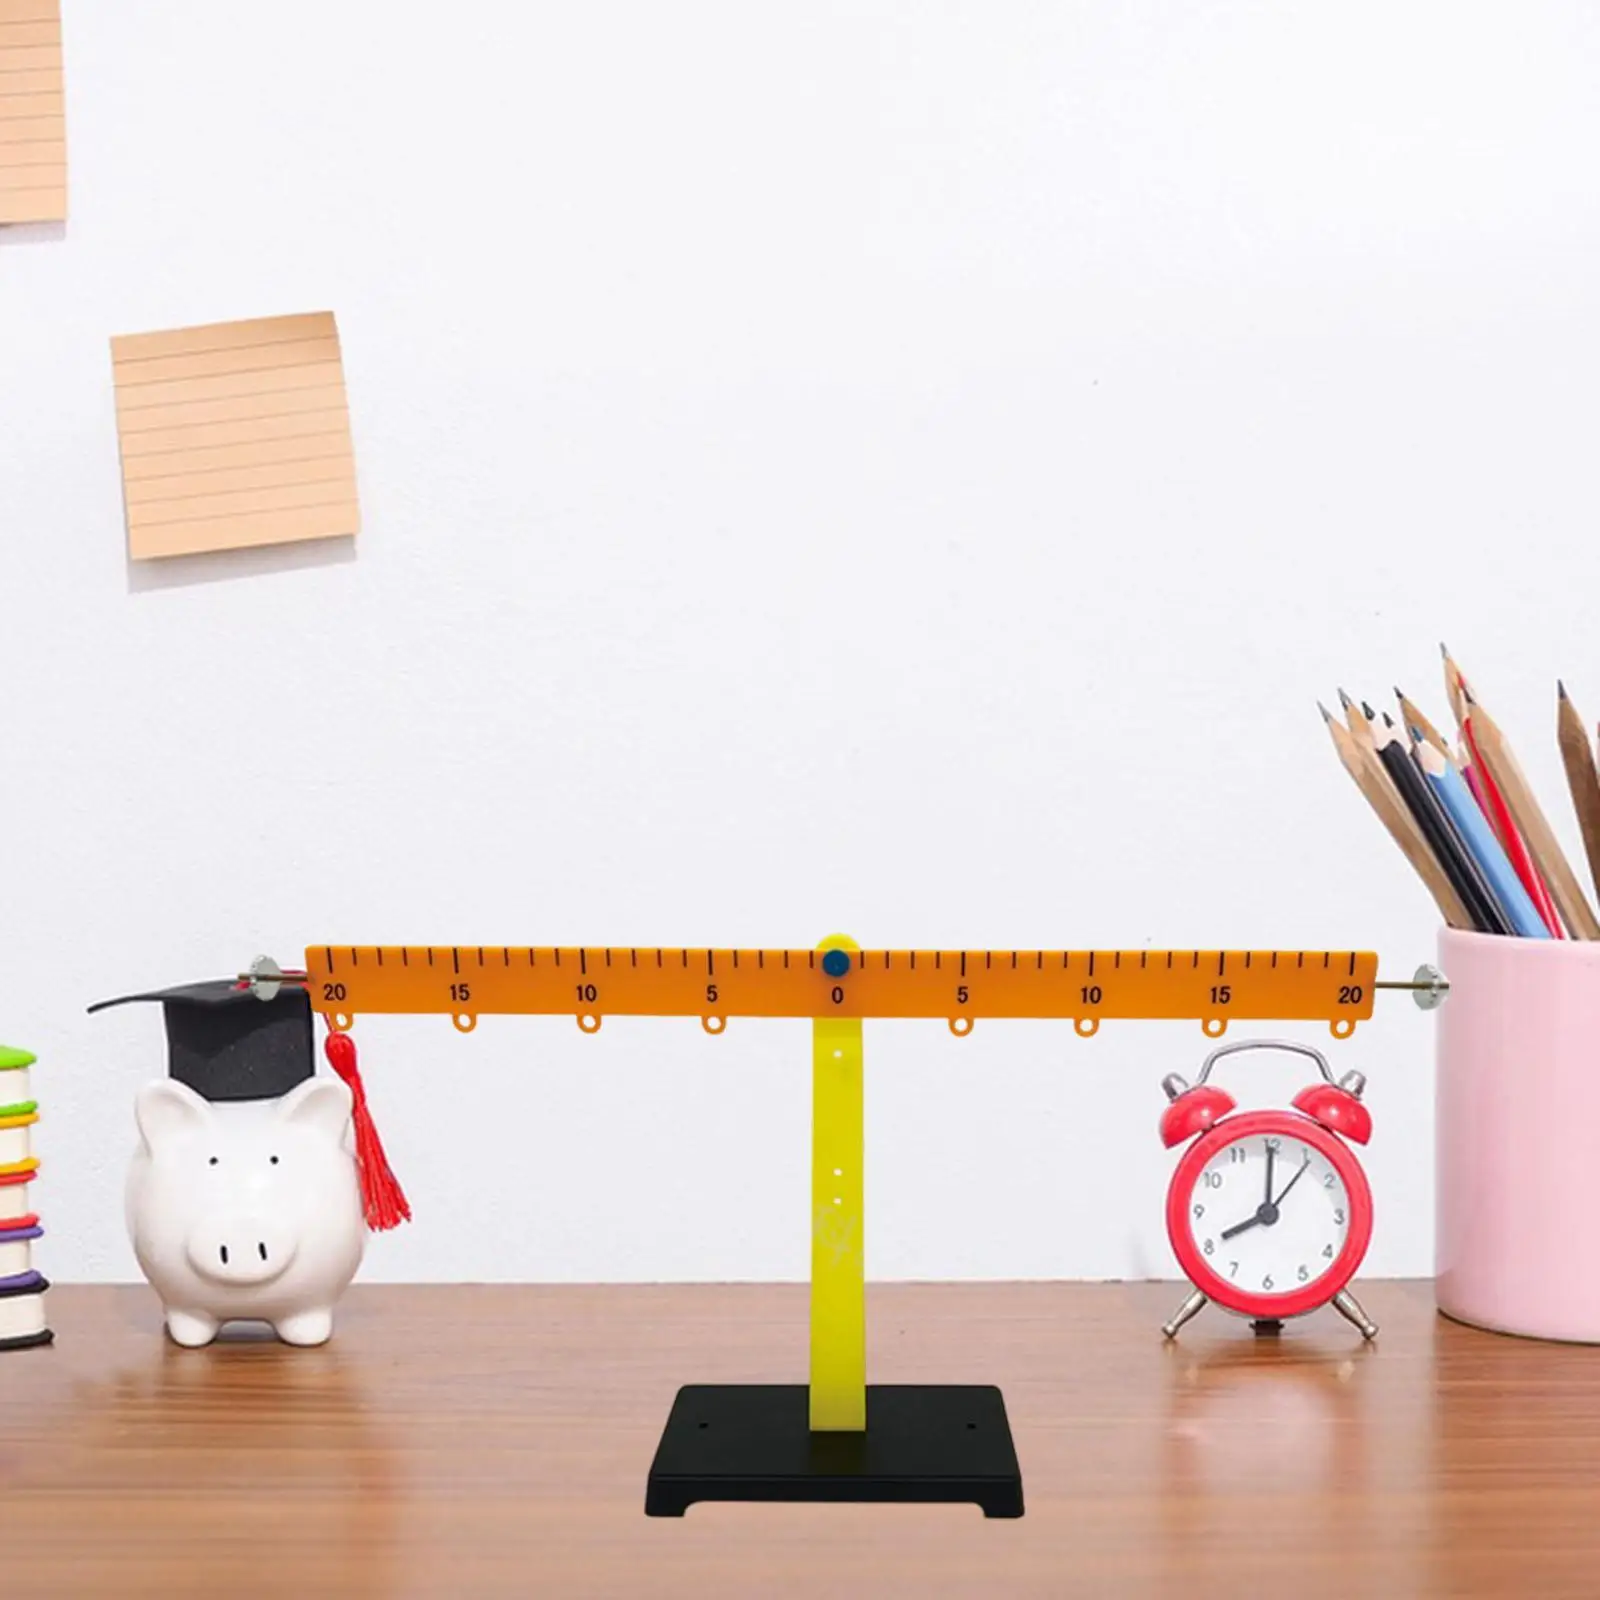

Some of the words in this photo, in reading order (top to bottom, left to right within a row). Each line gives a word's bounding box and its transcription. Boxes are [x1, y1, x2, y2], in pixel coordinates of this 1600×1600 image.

[324, 983, 346, 1001] 20
[450, 983, 470, 1002] 15
[576, 985, 597, 1003] 10
[706, 984, 718, 1003] 5
[831, 986, 844, 1005] 0
[957, 985, 969, 1004] 5
[1080, 986, 1102, 1005] 10
[1210, 986, 1231, 1005] 15
[1338, 985, 1362, 1005] 20
[1263, 1137, 1281, 1155] 12
[1230, 1147, 1246, 1163] 11
[1204, 1172, 1222, 1189] 10
[1324, 1173, 1337, 1189] 2
[1193, 1204, 1205, 1219] 9
[1333, 1209, 1345, 1225] 3
[1203, 1238, 1215, 1255] 8
[1322, 1243, 1333, 1258] 4
[1229, 1262, 1239, 1277] 7
[1297, 1264, 1309, 1281] 5
[1262, 1274, 1274, 1290] 6
